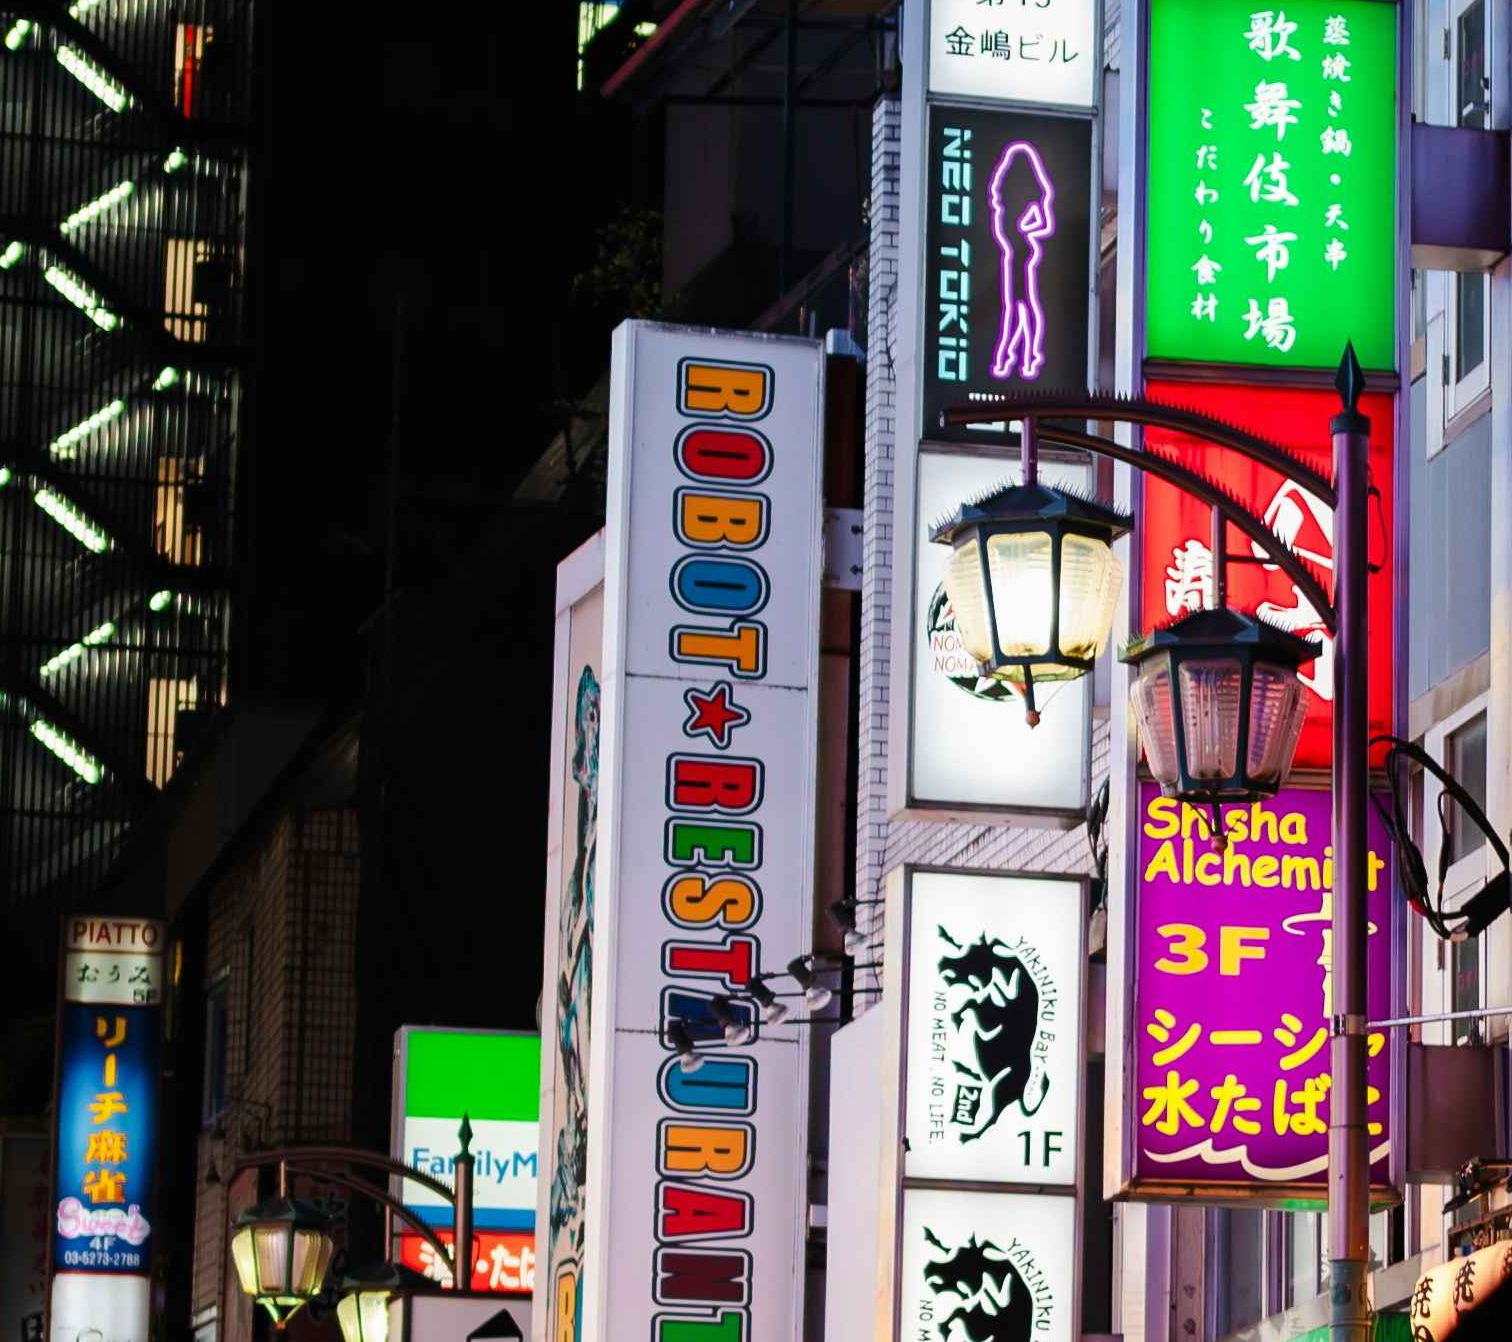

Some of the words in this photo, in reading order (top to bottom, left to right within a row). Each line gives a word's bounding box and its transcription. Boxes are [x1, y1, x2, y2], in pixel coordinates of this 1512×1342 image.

[945, 25, 1079, 64] 金嶋ビル
[941, 127, 972, 227] NEO
[1241, 10, 1302, 352] 歌舞伎市場
[1191, 108, 1222, 322] こだわり食材
[938, 239, 971, 381] TOKIO
[669, 356, 775, 681] ROBOT
[1144, 797, 1307, 844] Shsha
[1144, 839, 1384, 891] Alchemit
[73, 922, 158, 947] PIATTO
[1154, 924, 1270, 976] 3F
[934, 992, 946, 1012] NO
[1015, 936, 1057, 1021] YAKINIKU
[1147, 1009, 1385, 1070] シーシ
[83, 1016, 128, 1204] リーチ麻雀
[931, 1077, 944, 1096] NO
[956, 1086, 979, 1124] 2nd
[1017, 1131, 1063, 1167] 1F
[920, 1299, 932, 1320] NO
[1007, 1237, 1054, 1331] YAKINIKU
